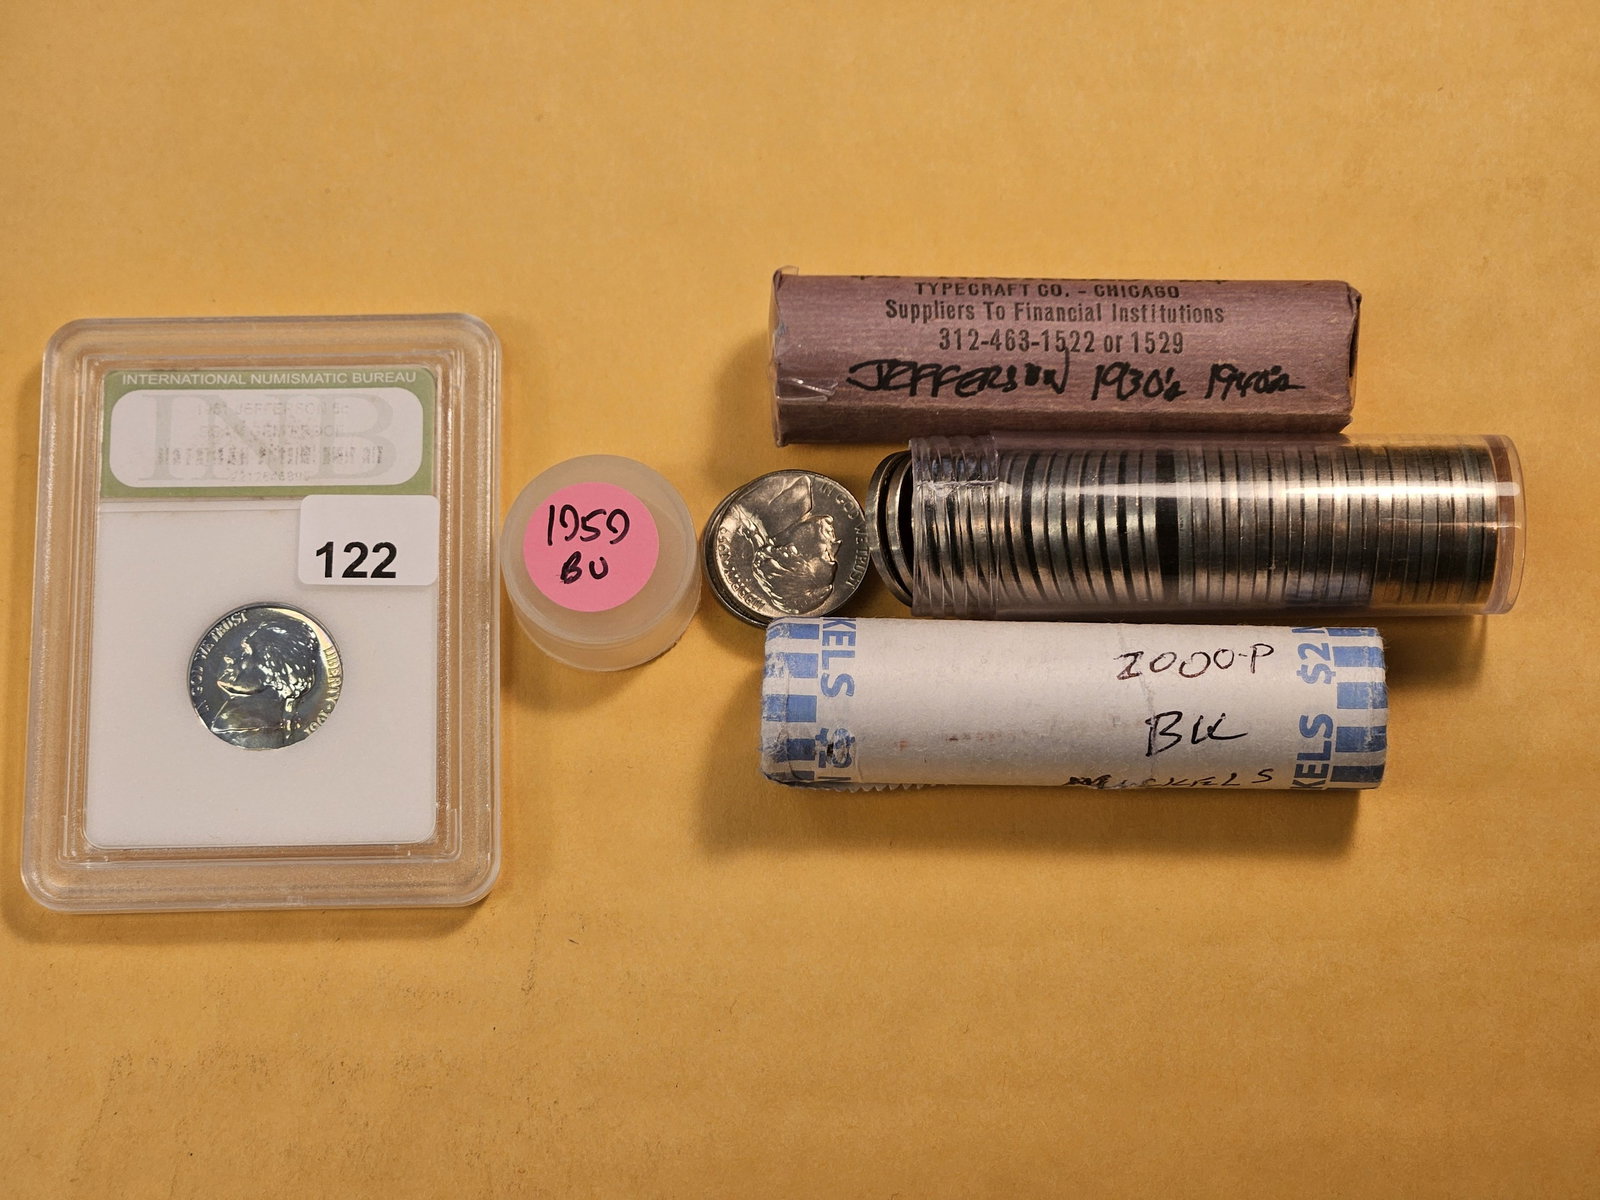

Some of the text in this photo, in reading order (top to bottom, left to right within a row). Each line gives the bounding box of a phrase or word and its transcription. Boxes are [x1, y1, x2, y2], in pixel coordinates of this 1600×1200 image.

[914, 282, 1031, 297] TYPECRAFT
[1037, 284, 1070, 298] CO.
[1094, 284, 1180, 299] CHICAGO
[885, 299, 1225, 324] Suppliers To Financial Institutions
[939, 327, 1184, 354] 312-463-1522 or 1529
[122, 371, 417, 386] INTERNATIONAL NUMISMATIC BUREAU
[315, 541, 398, 579] 122
[559, 551, 610, 584] BU
[845, 551, 868, 591] TRUST
[208, 609, 249, 643] TRUST
[1296, 643, 1336, 685] $2
